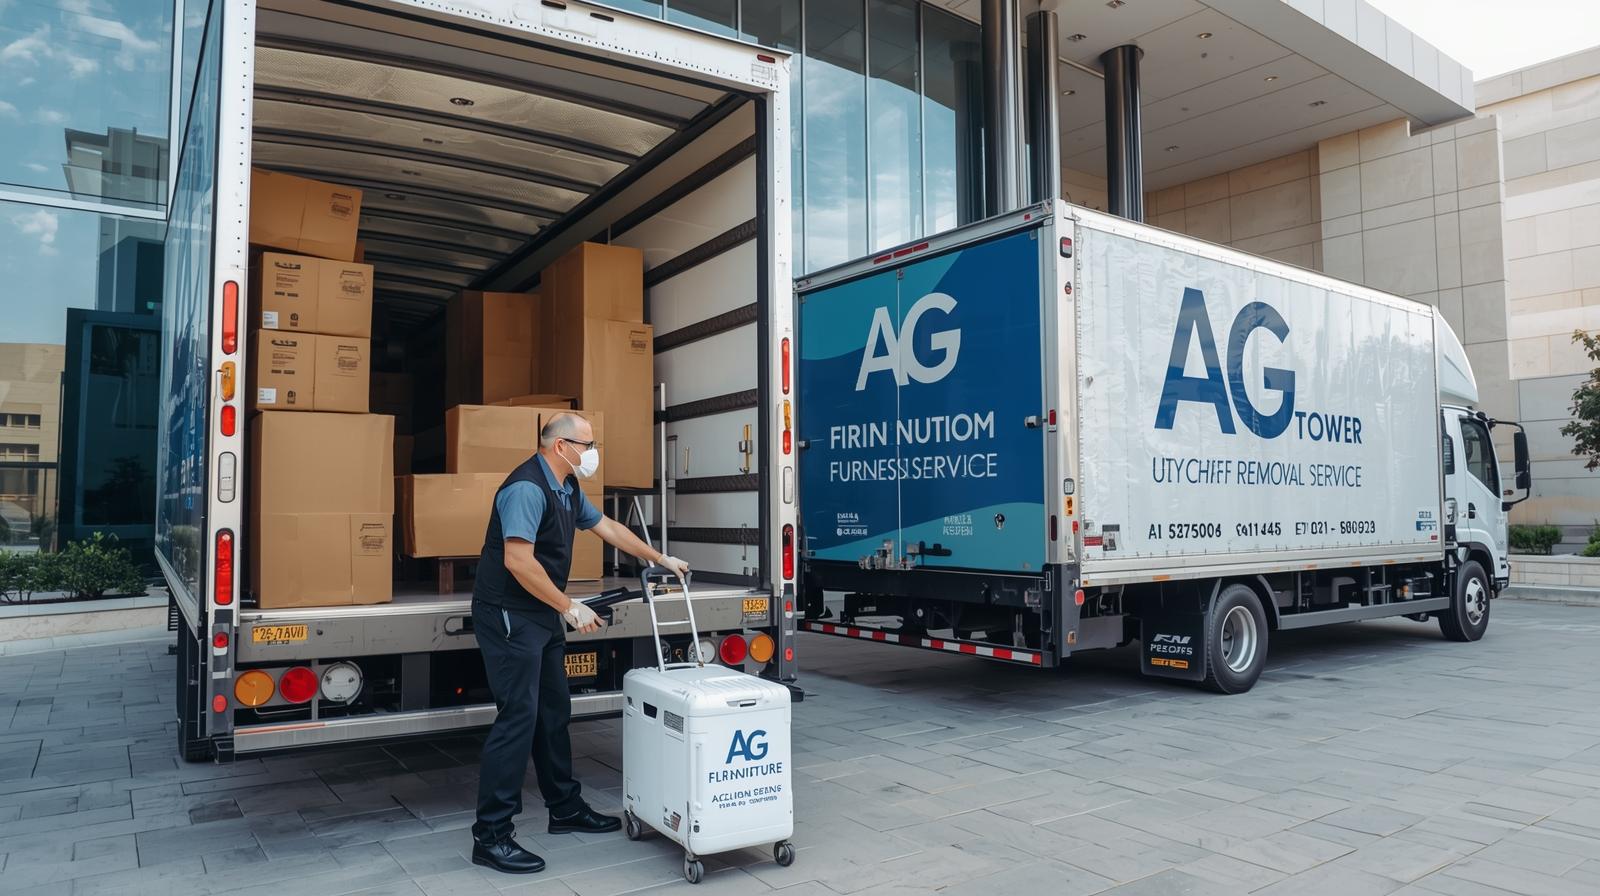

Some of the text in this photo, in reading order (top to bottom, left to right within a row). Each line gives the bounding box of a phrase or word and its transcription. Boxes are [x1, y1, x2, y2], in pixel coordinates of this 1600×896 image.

[855, 292, 961, 391] AG
[1154, 287, 1362, 444] AG TOWER
[830, 411, 995, 450] FIRIN NUTIOM
[1237, 460, 1305, 486] REMOVAL
[1309, 464, 1362, 487] SERVICE
[725, 729, 769, 764] AG
